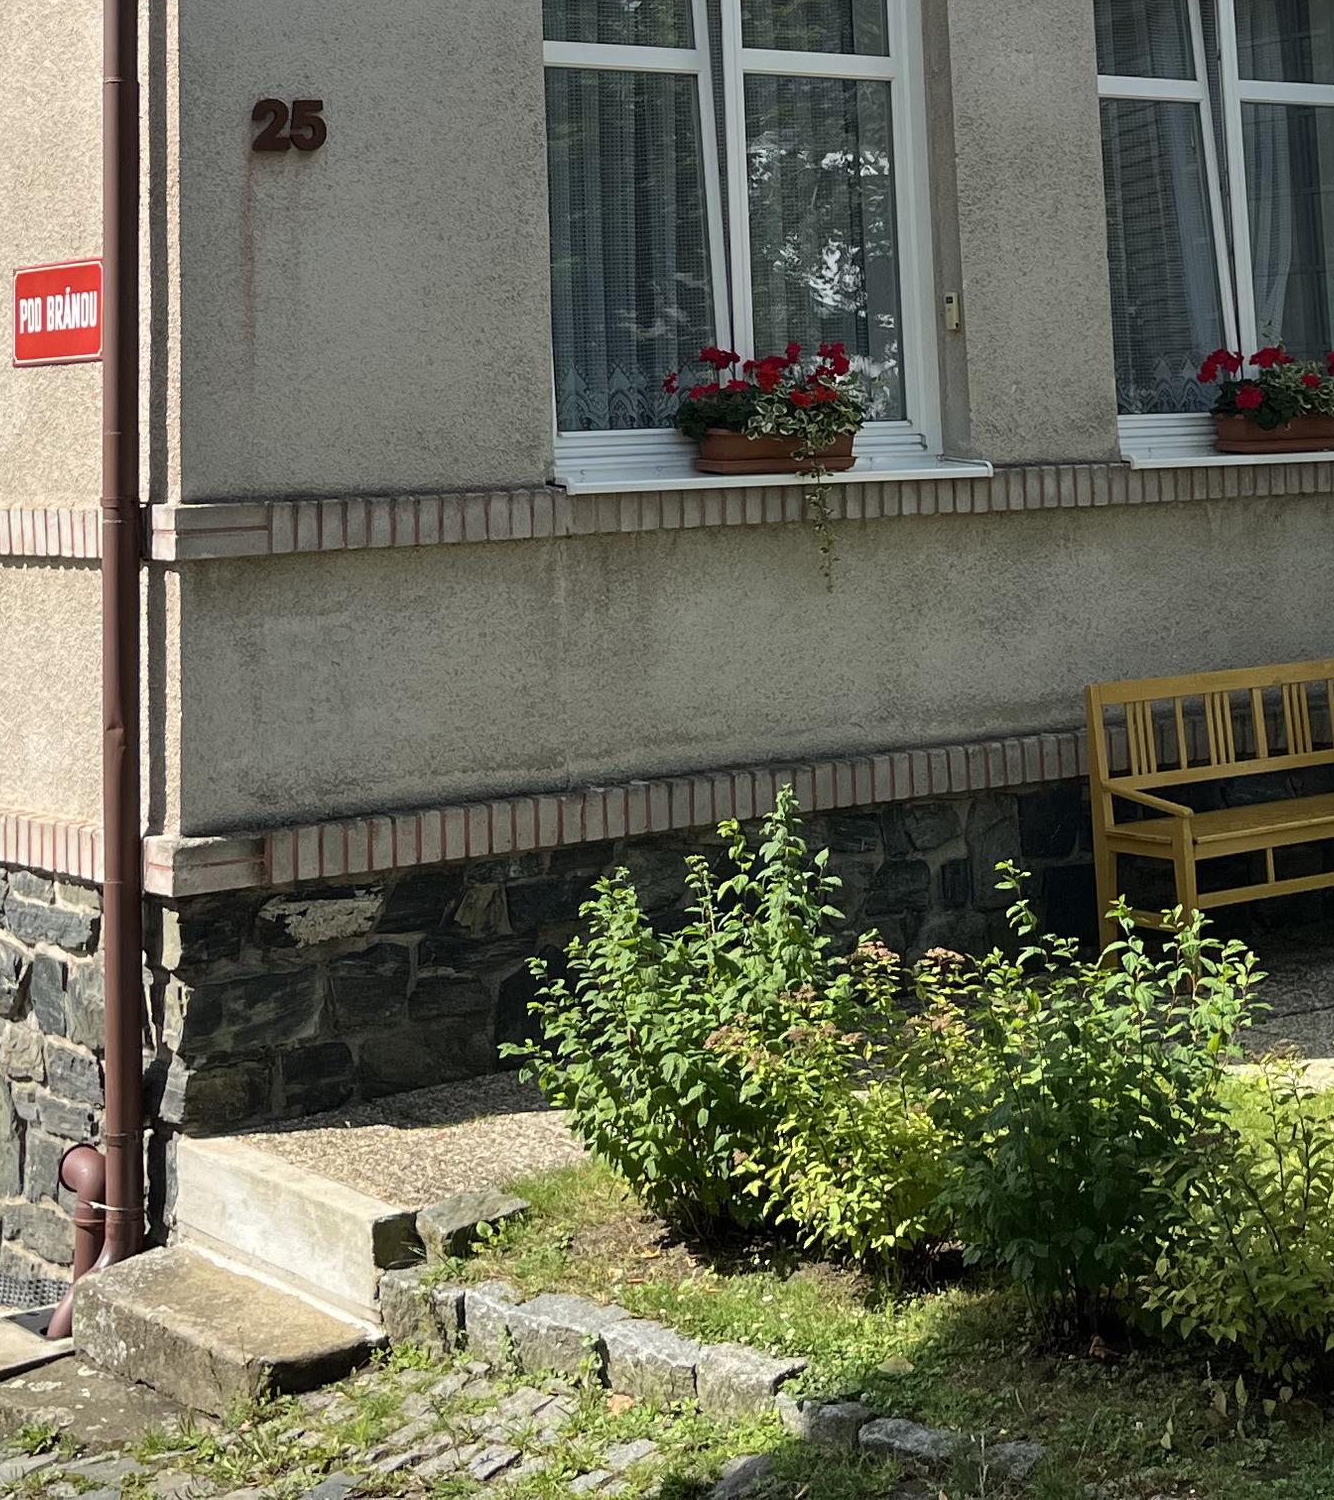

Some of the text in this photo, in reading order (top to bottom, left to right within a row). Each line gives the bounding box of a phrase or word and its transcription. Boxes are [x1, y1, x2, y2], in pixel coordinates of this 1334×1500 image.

[251, 98, 327, 151] 25
[19, 286, 97, 334] POD BRÁNOU
